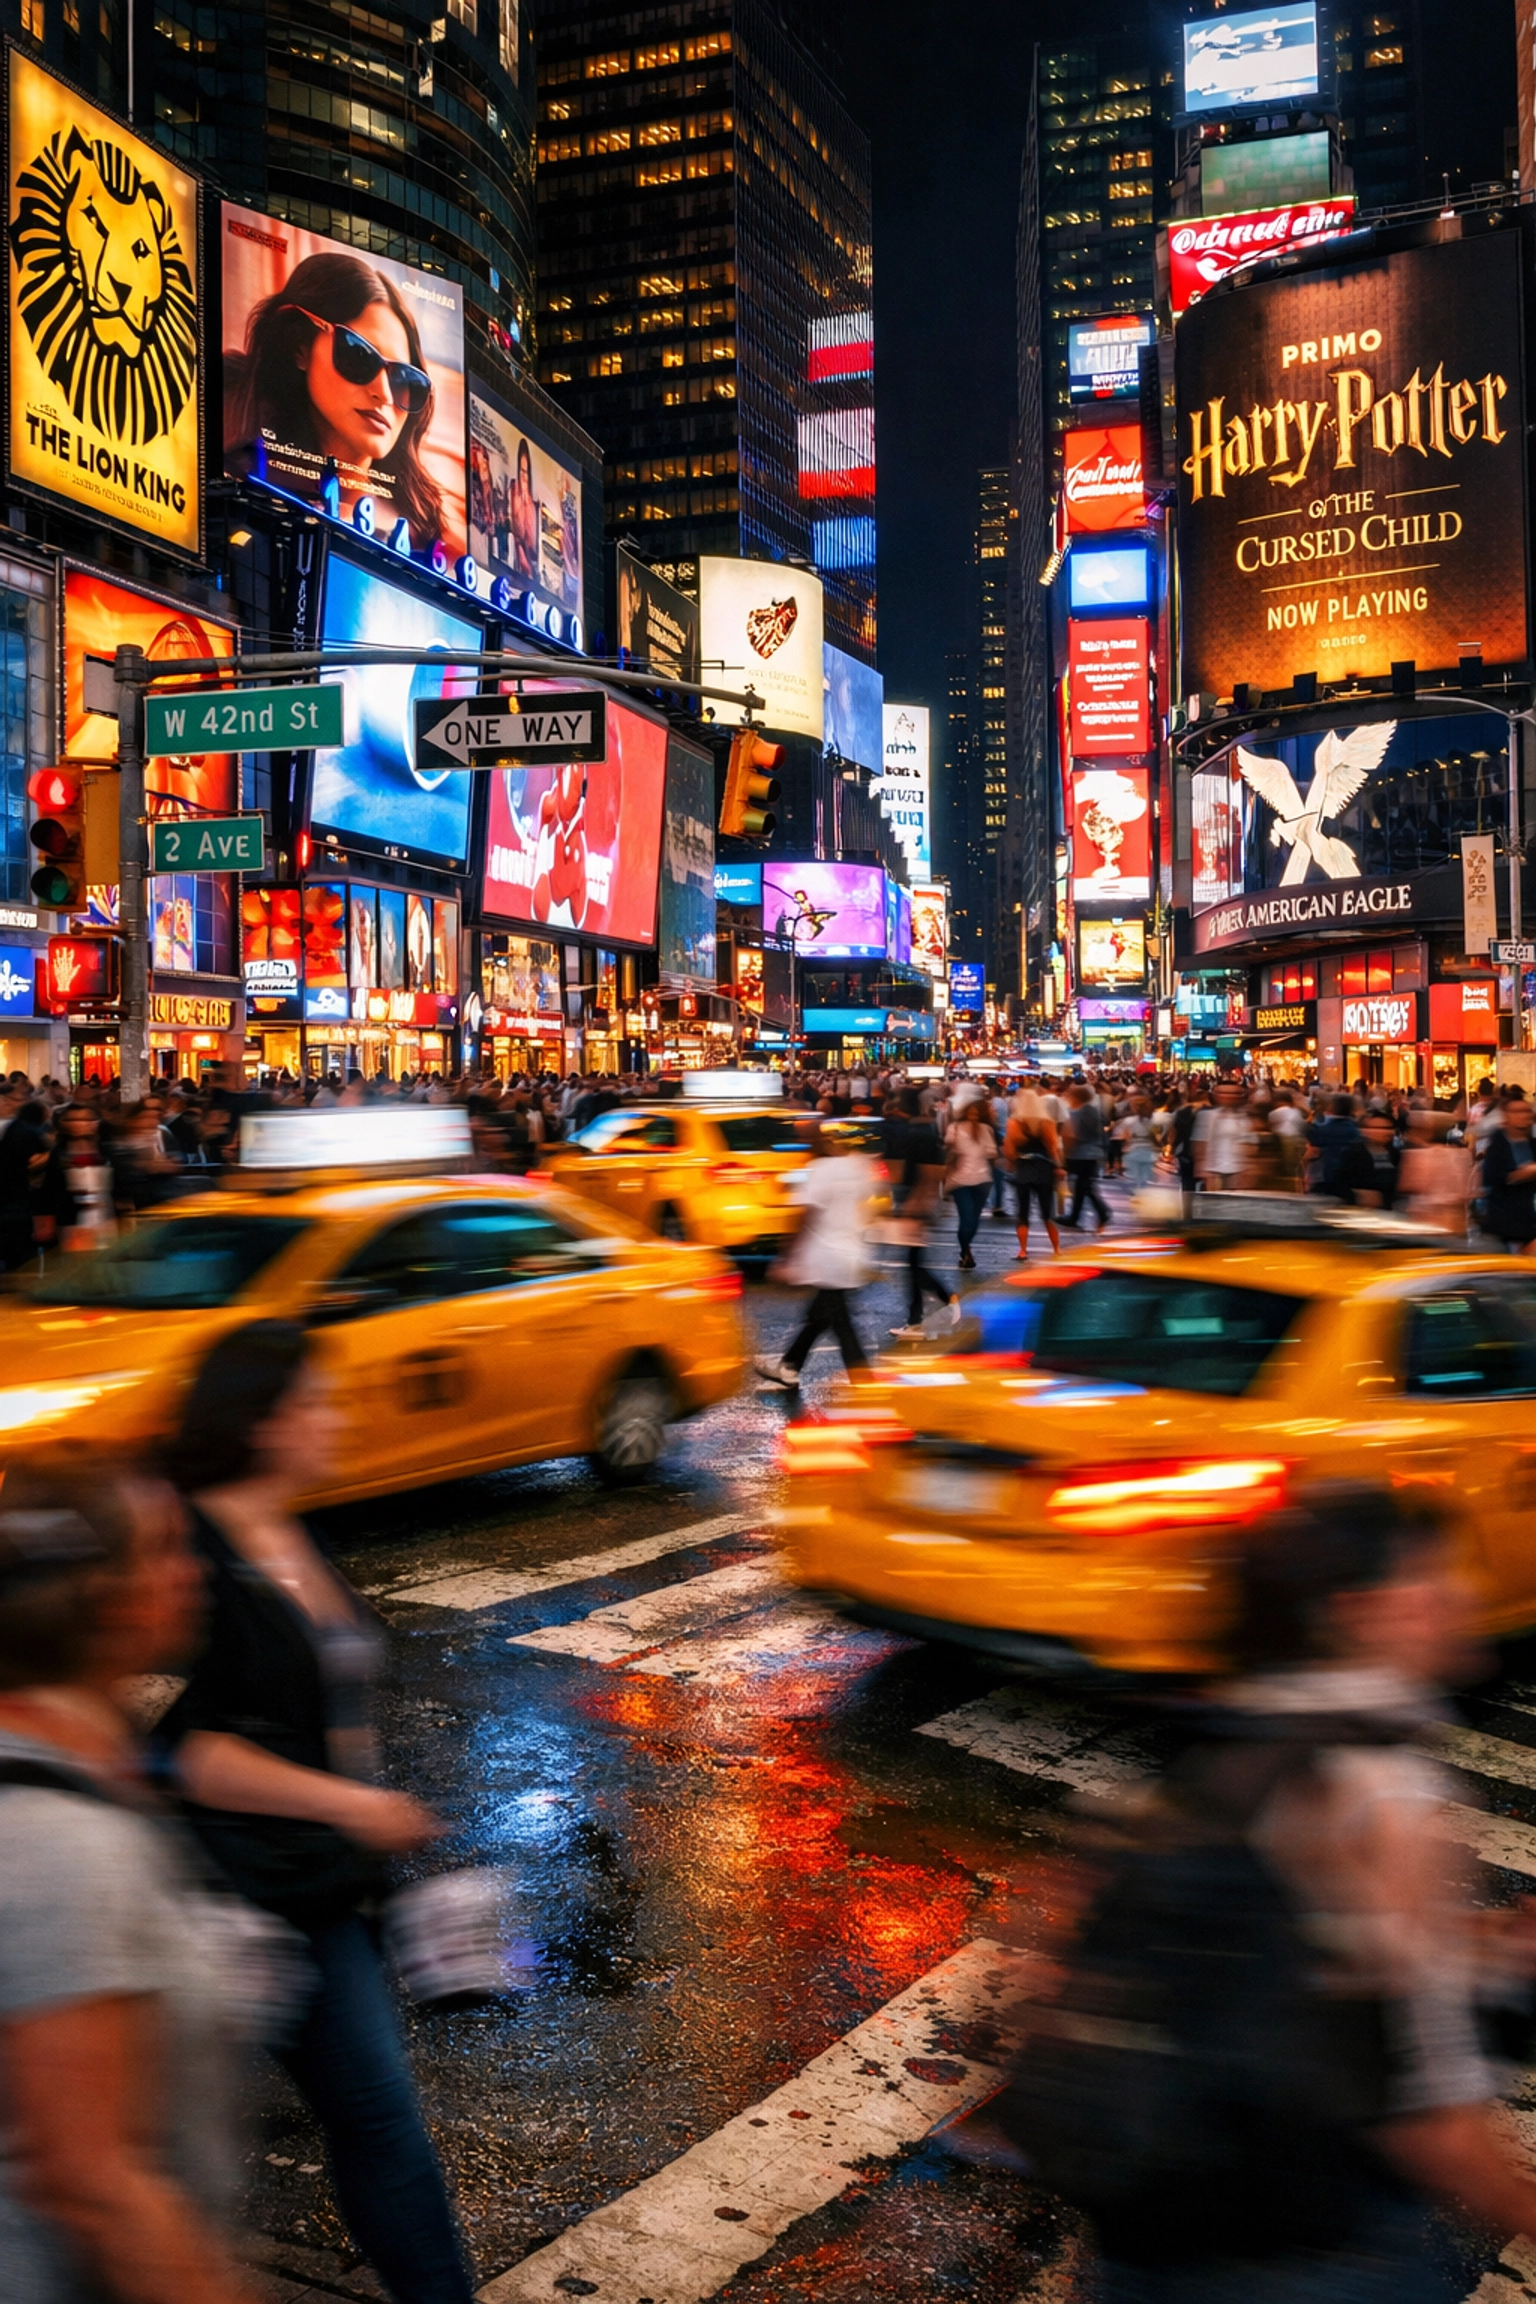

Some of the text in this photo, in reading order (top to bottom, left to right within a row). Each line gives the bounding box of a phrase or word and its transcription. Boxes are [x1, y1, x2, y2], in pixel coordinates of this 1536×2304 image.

[1281, 328, 1382, 369] PRIMO
[1182, 395, 1328, 504] Harry
[1328, 360, 1508, 471] Potter
[26, 409, 71, 462] THE
[77, 434, 128, 489] LION
[133, 462, 187, 514] KING
[1332, 490, 1375, 516] THE
[1236, 510, 1463, 573] CURSED CHILD
[1267, 586, 1429, 631] NOW PLAYING
[164, 702, 319, 738] W 42nd St
[444, 714, 583, 746] ONE WAY
[164, 831, 181, 862] 2
[1246, 893, 1338, 929] AMERICAN
[1341, 884, 1412, 916] EAGLE
